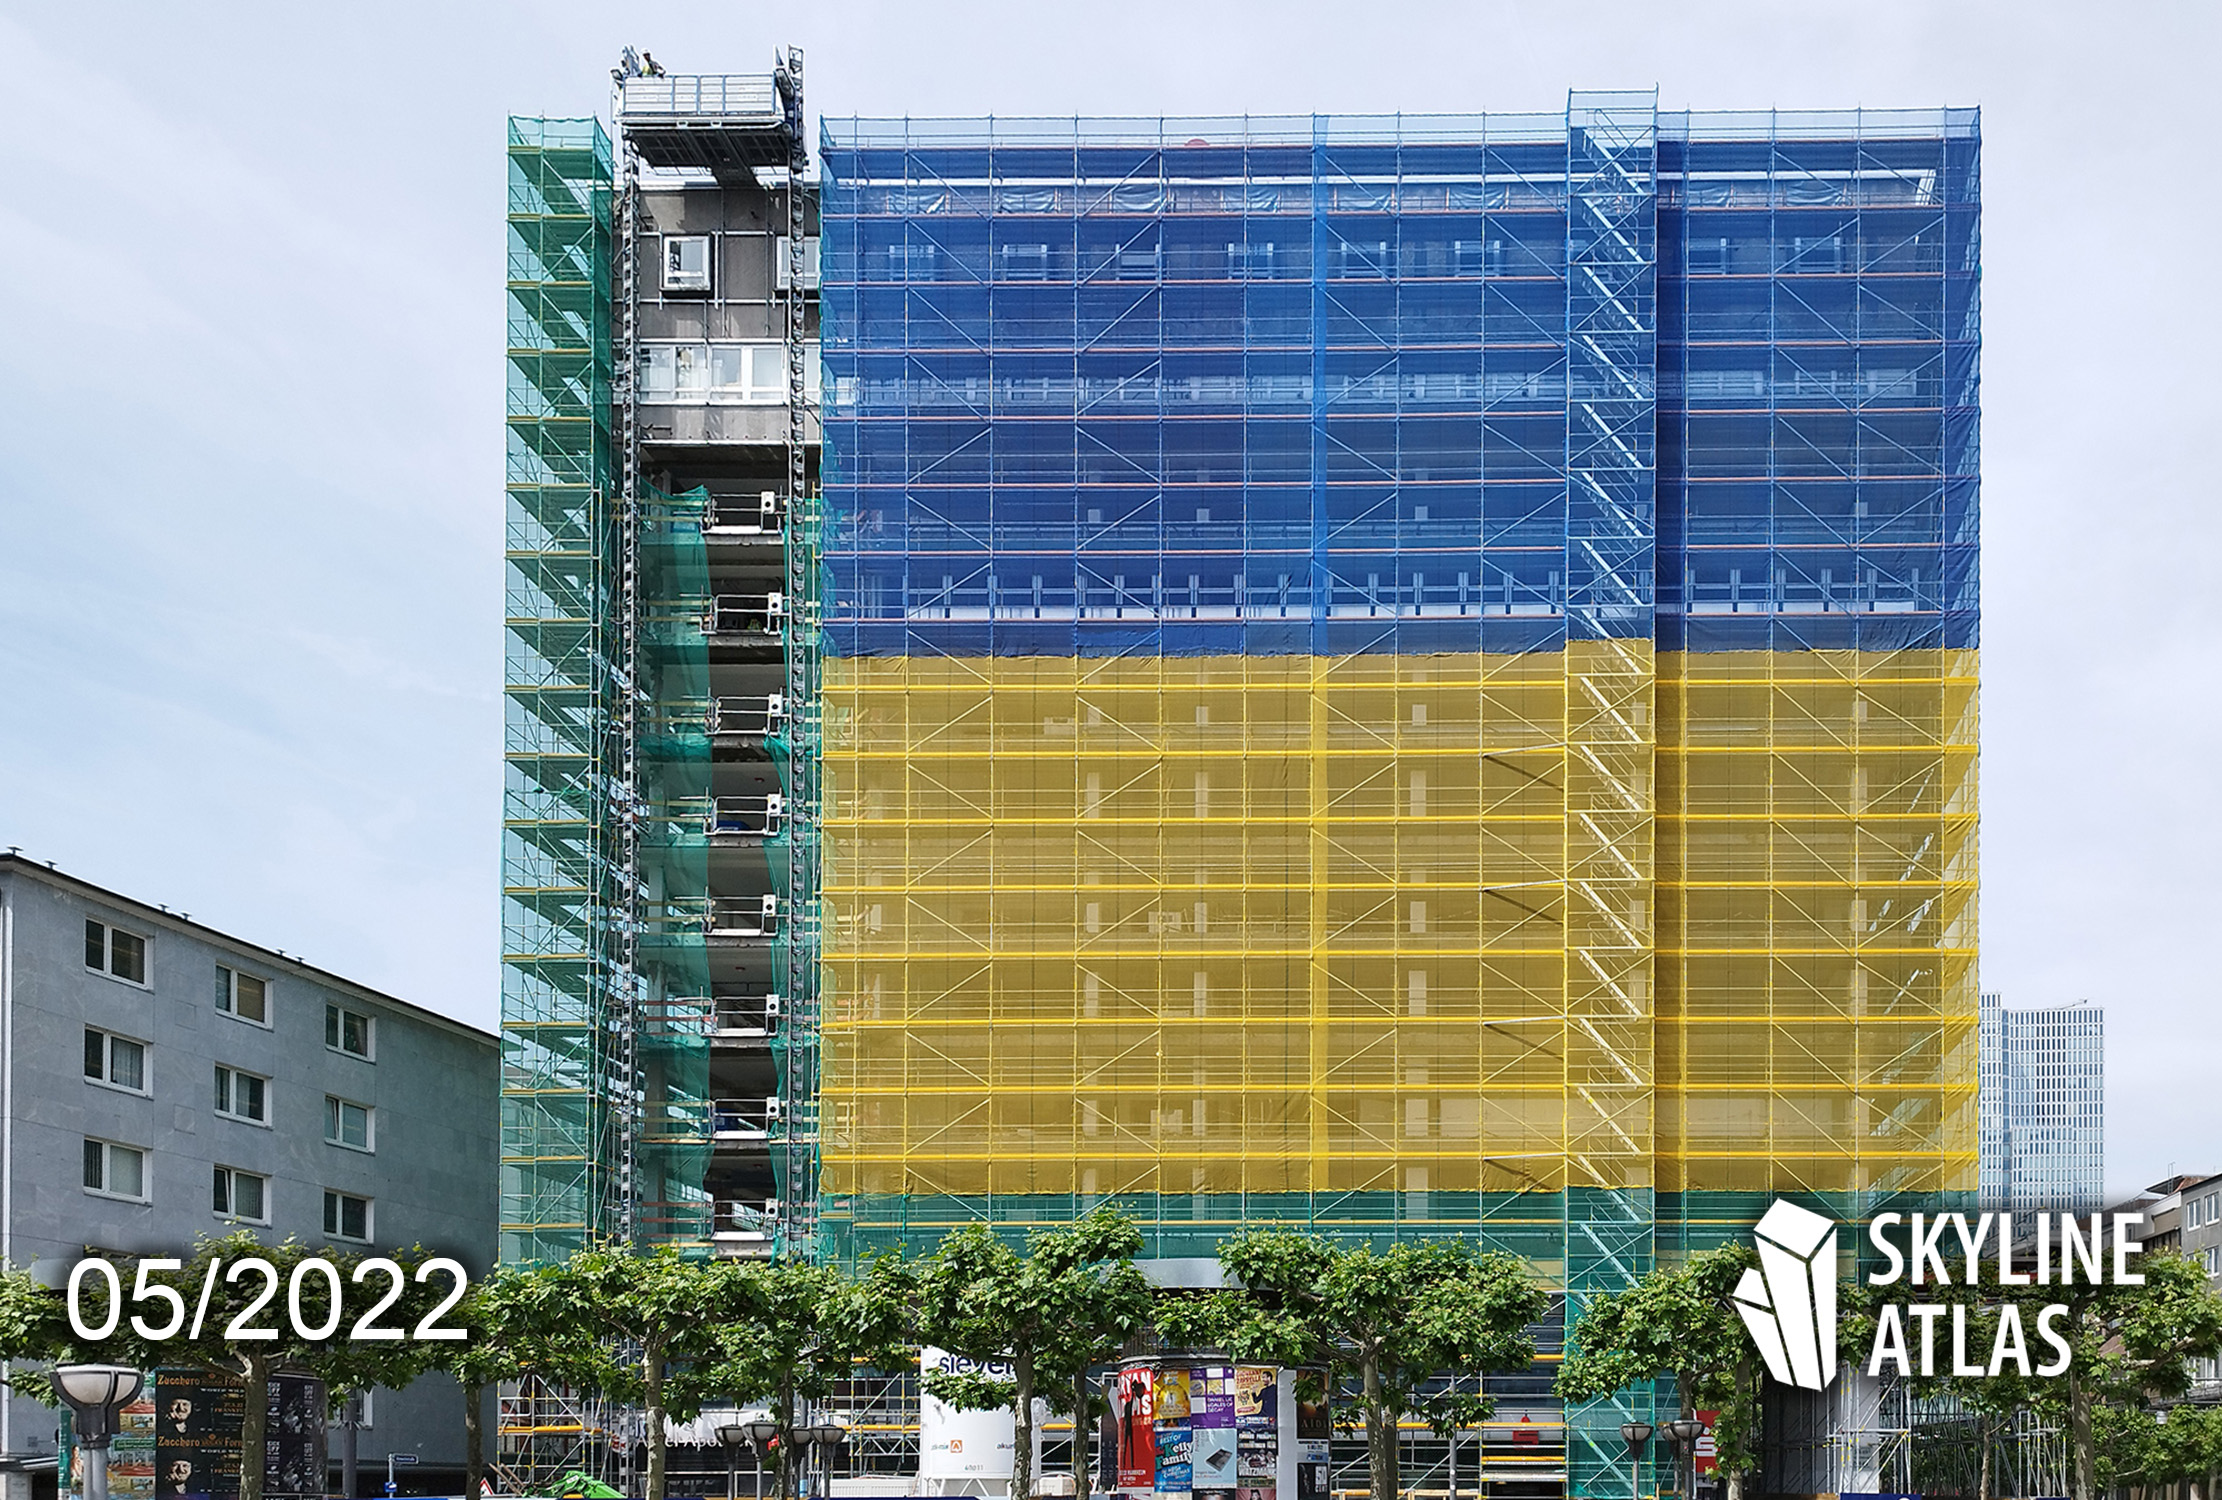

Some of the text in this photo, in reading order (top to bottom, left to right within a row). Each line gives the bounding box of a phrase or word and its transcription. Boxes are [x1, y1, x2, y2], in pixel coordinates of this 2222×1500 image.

[157, 1374, 201, 1386] Zucchero
[157, 1435, 201, 1448] Zucchero
[1163, 1441, 1193, 1457] Kelly
[1154, 1450, 1193, 1471] Family
